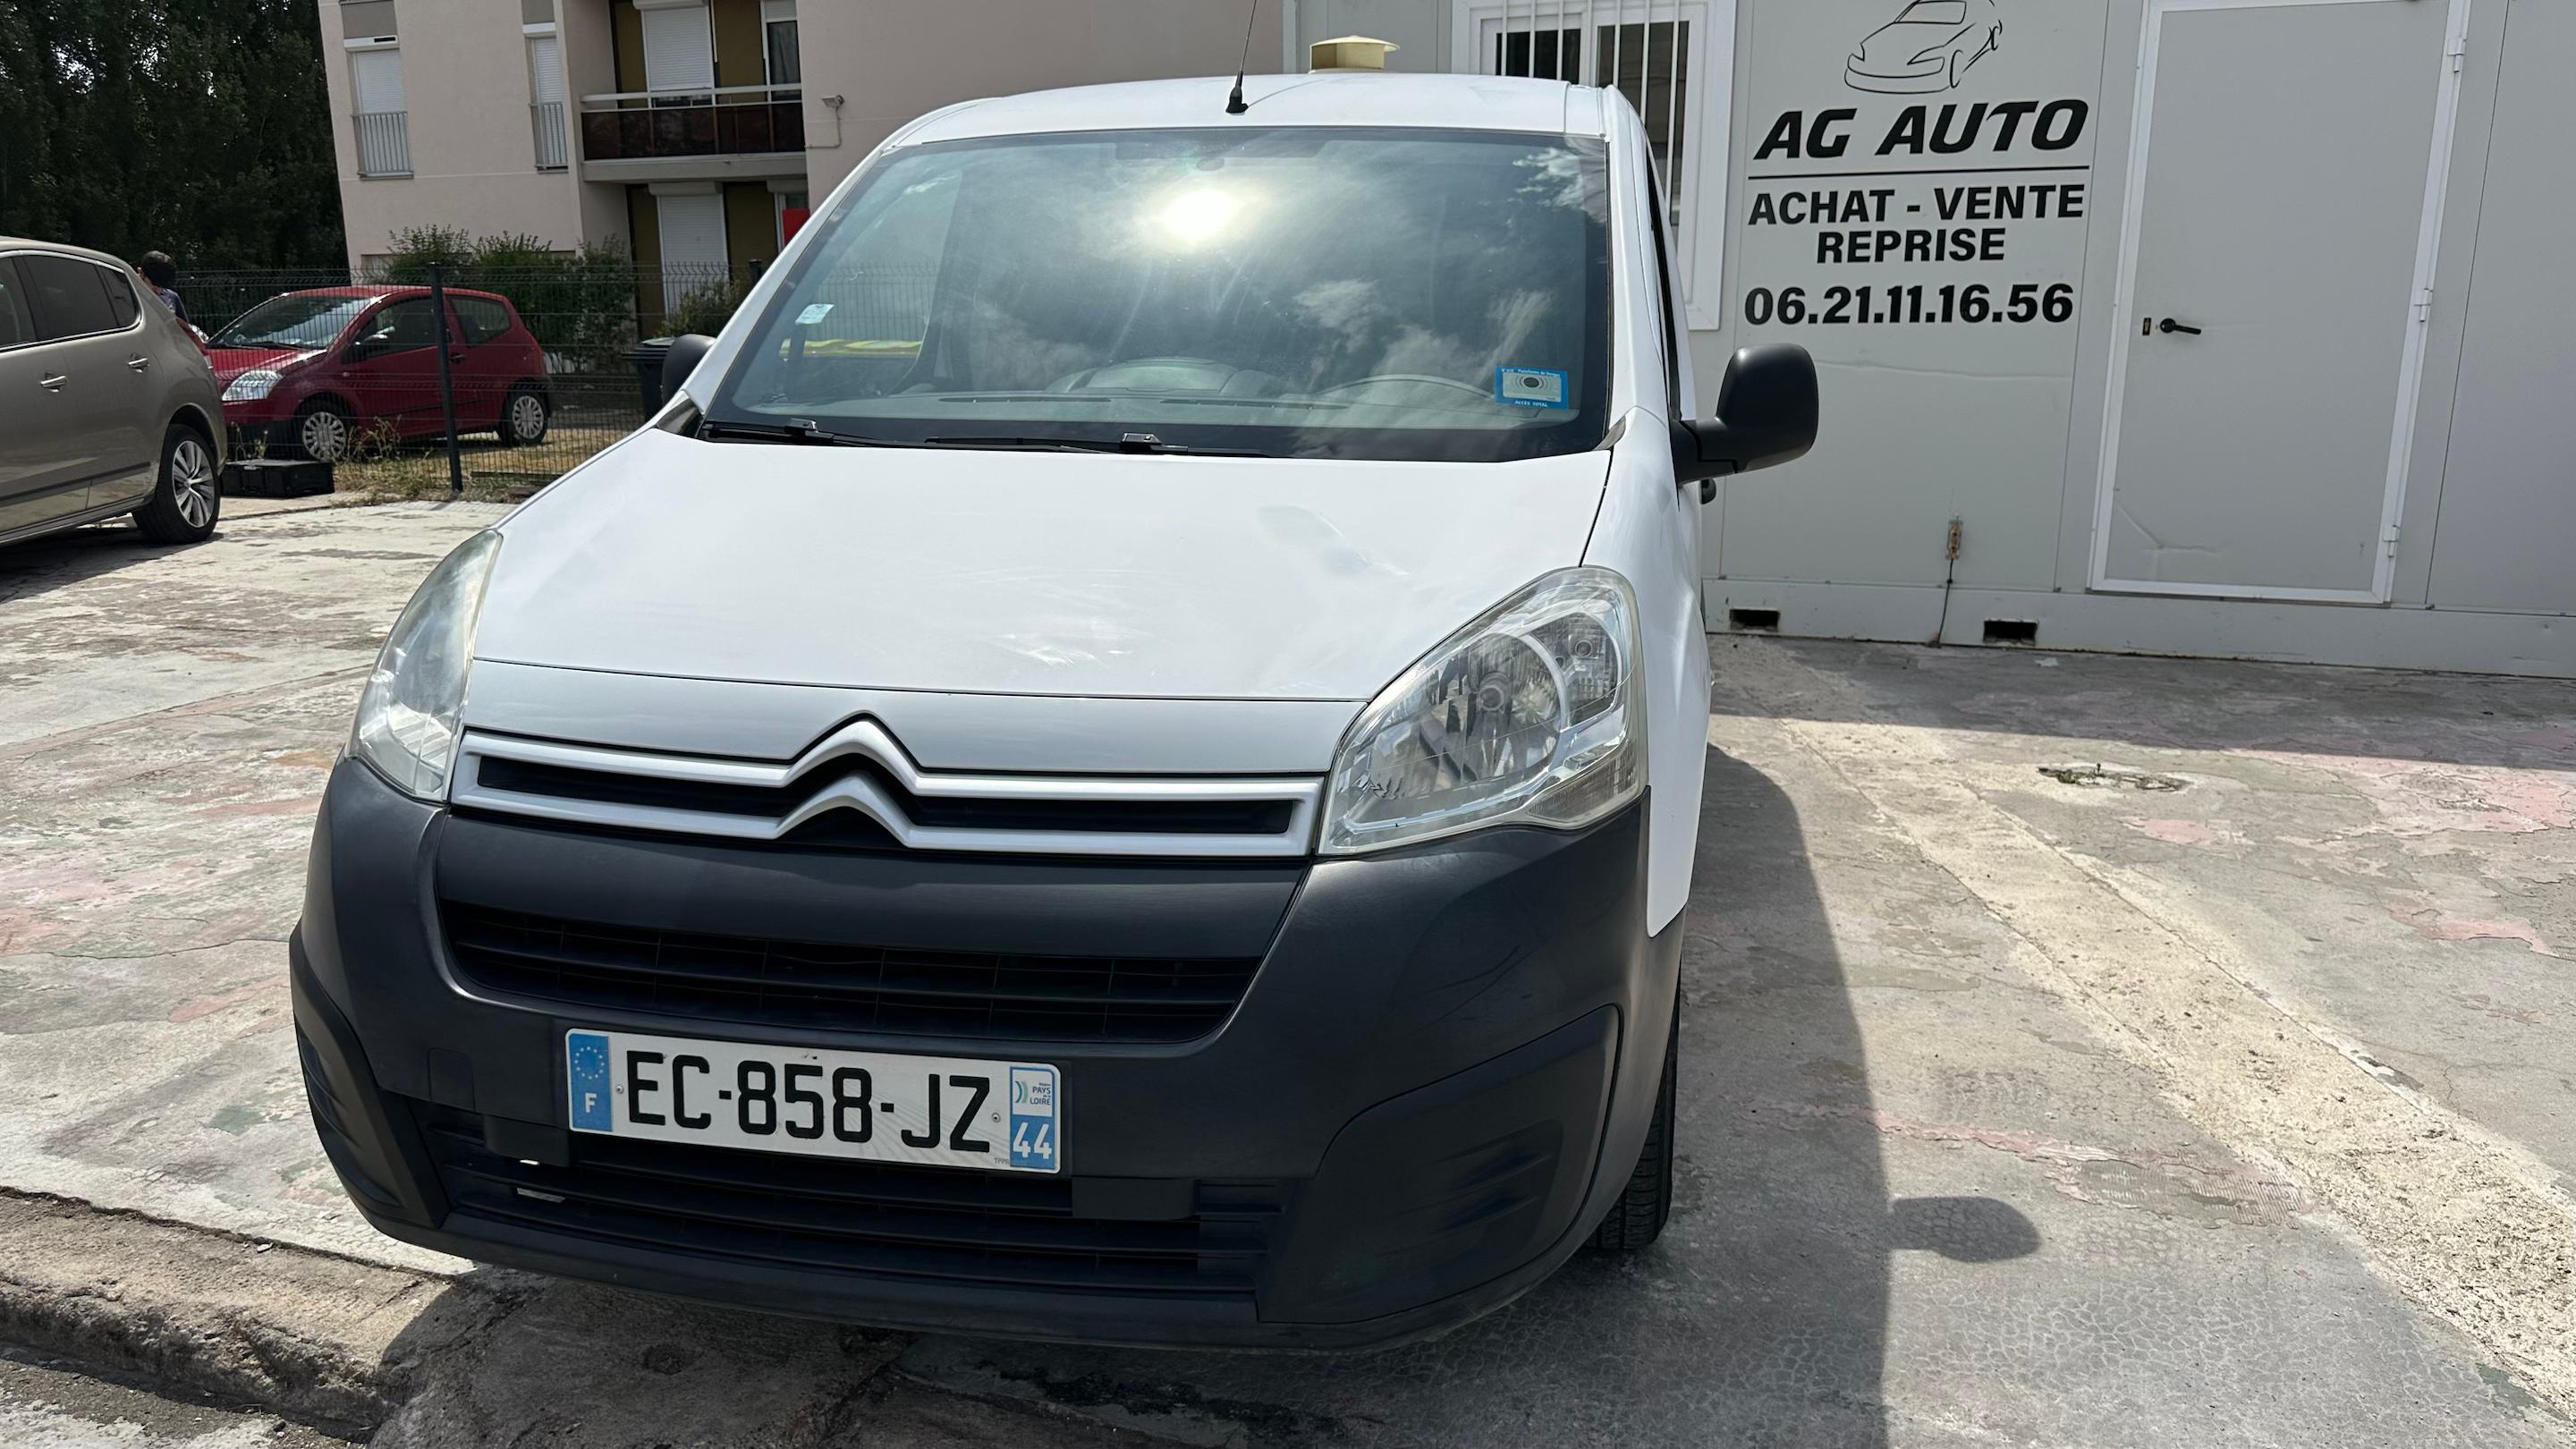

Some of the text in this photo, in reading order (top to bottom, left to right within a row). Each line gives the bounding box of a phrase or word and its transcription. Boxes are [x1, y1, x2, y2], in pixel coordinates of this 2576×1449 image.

[1753, 99, 2089, 160] AG AUTO
[1749, 190, 1894, 225] ACHAT
[1934, 184, 2084, 220] VENTE
[1818, 228, 2005, 263] REPRISE
[1745, 284, 2072, 325] 06.21.11.16.56
[585, 1050, 990, 1153] F EC-858-JZ
[1030, 1097, 1052, 1106] LOIRE
[1032, 1086, 1051, 1095] PAYS
[1013, 1122, 1053, 1159] 44
